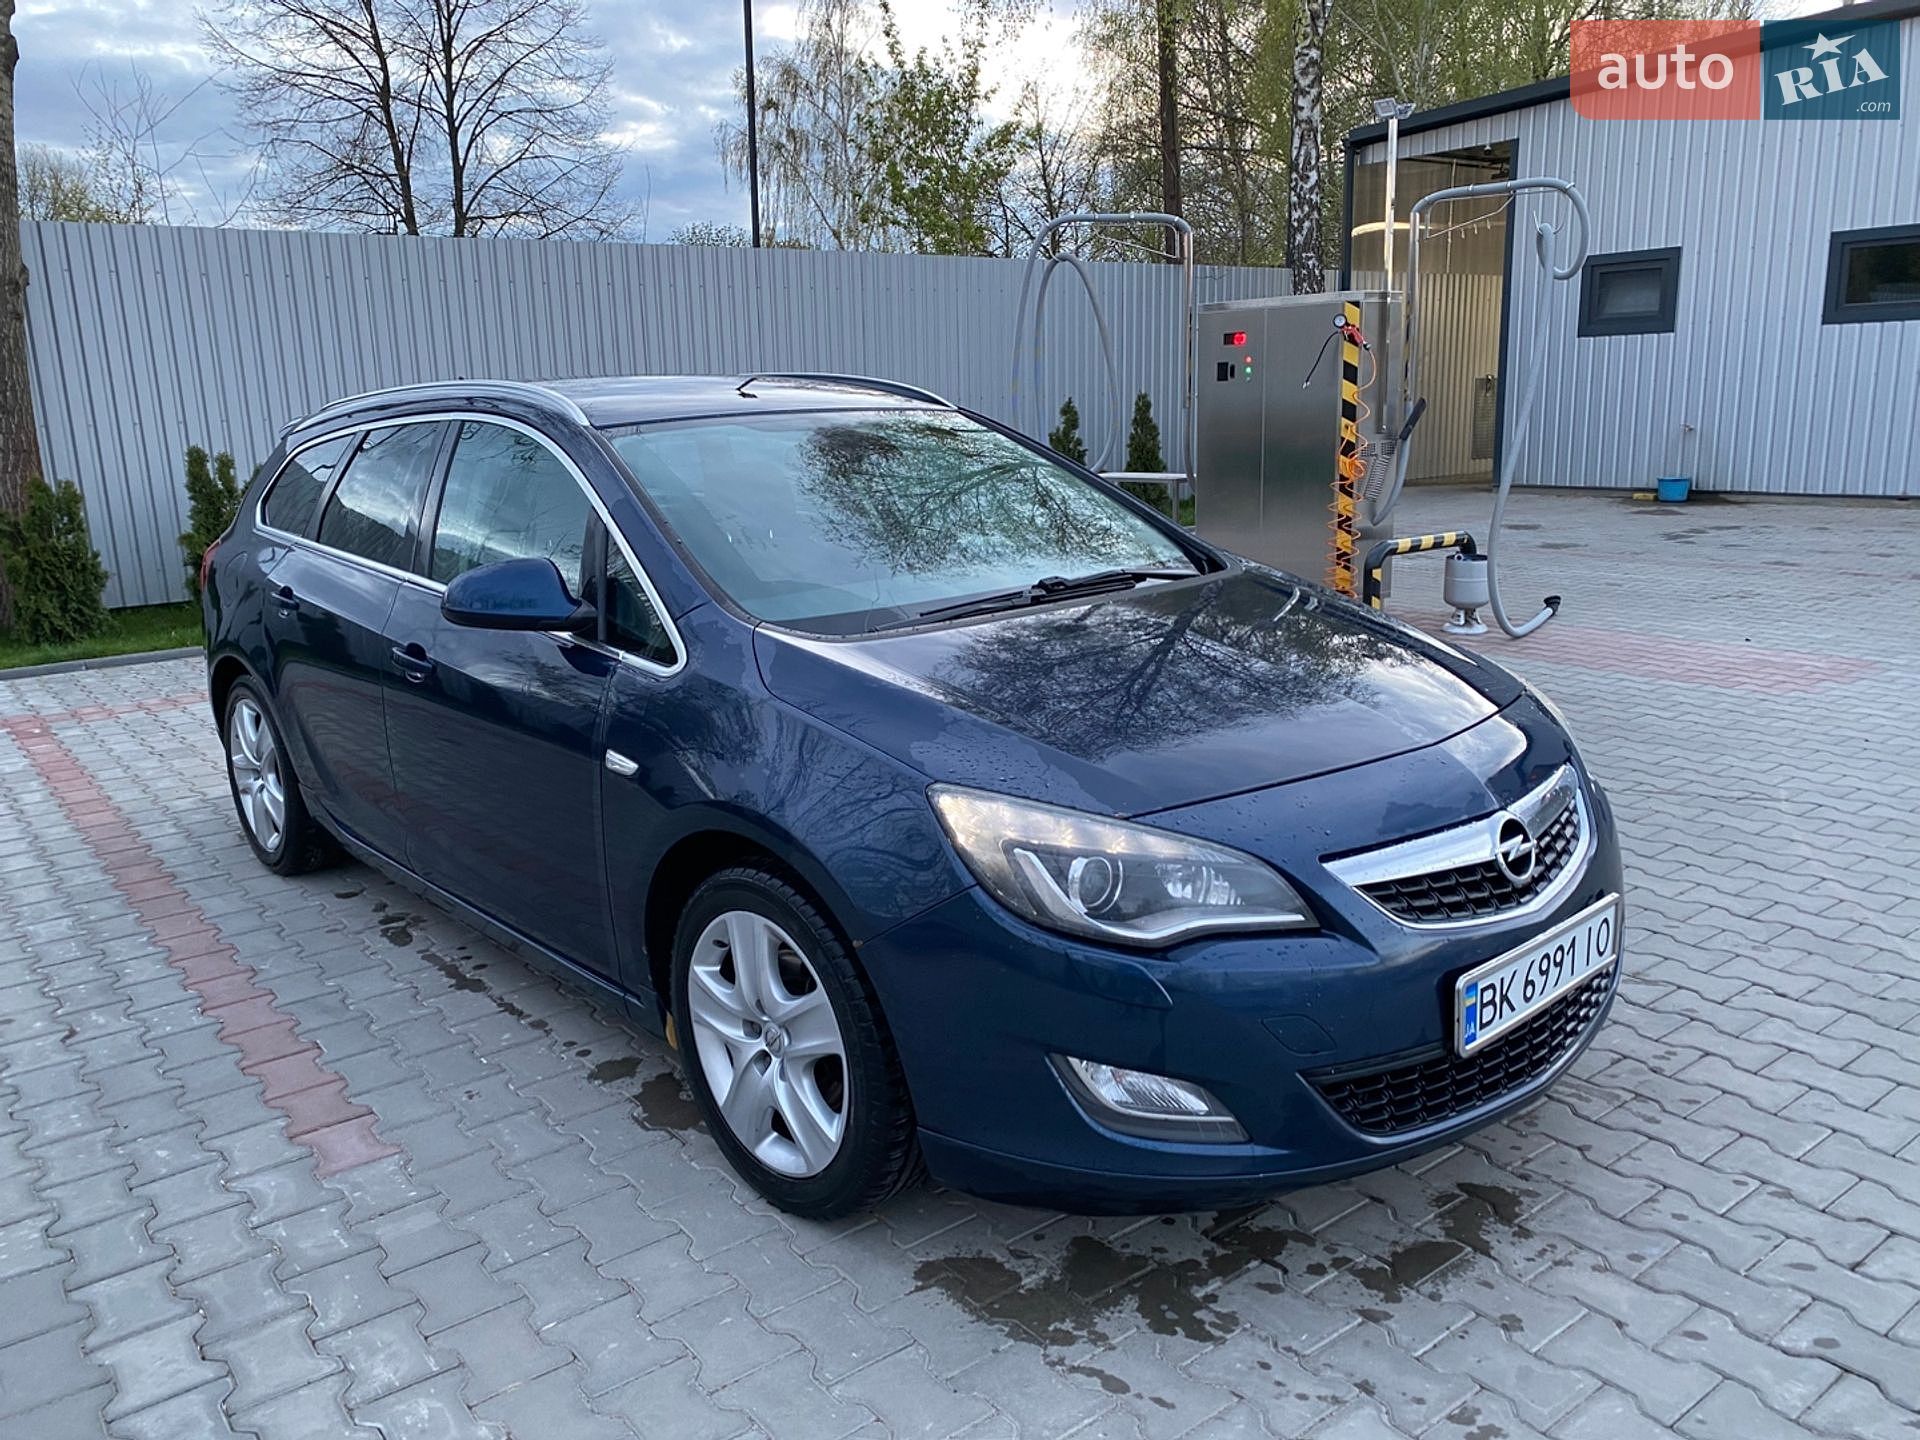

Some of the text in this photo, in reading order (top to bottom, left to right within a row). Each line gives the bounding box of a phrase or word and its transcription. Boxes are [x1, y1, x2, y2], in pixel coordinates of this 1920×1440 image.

[1479, 917, 1610, 1031] BK 6991 IO
